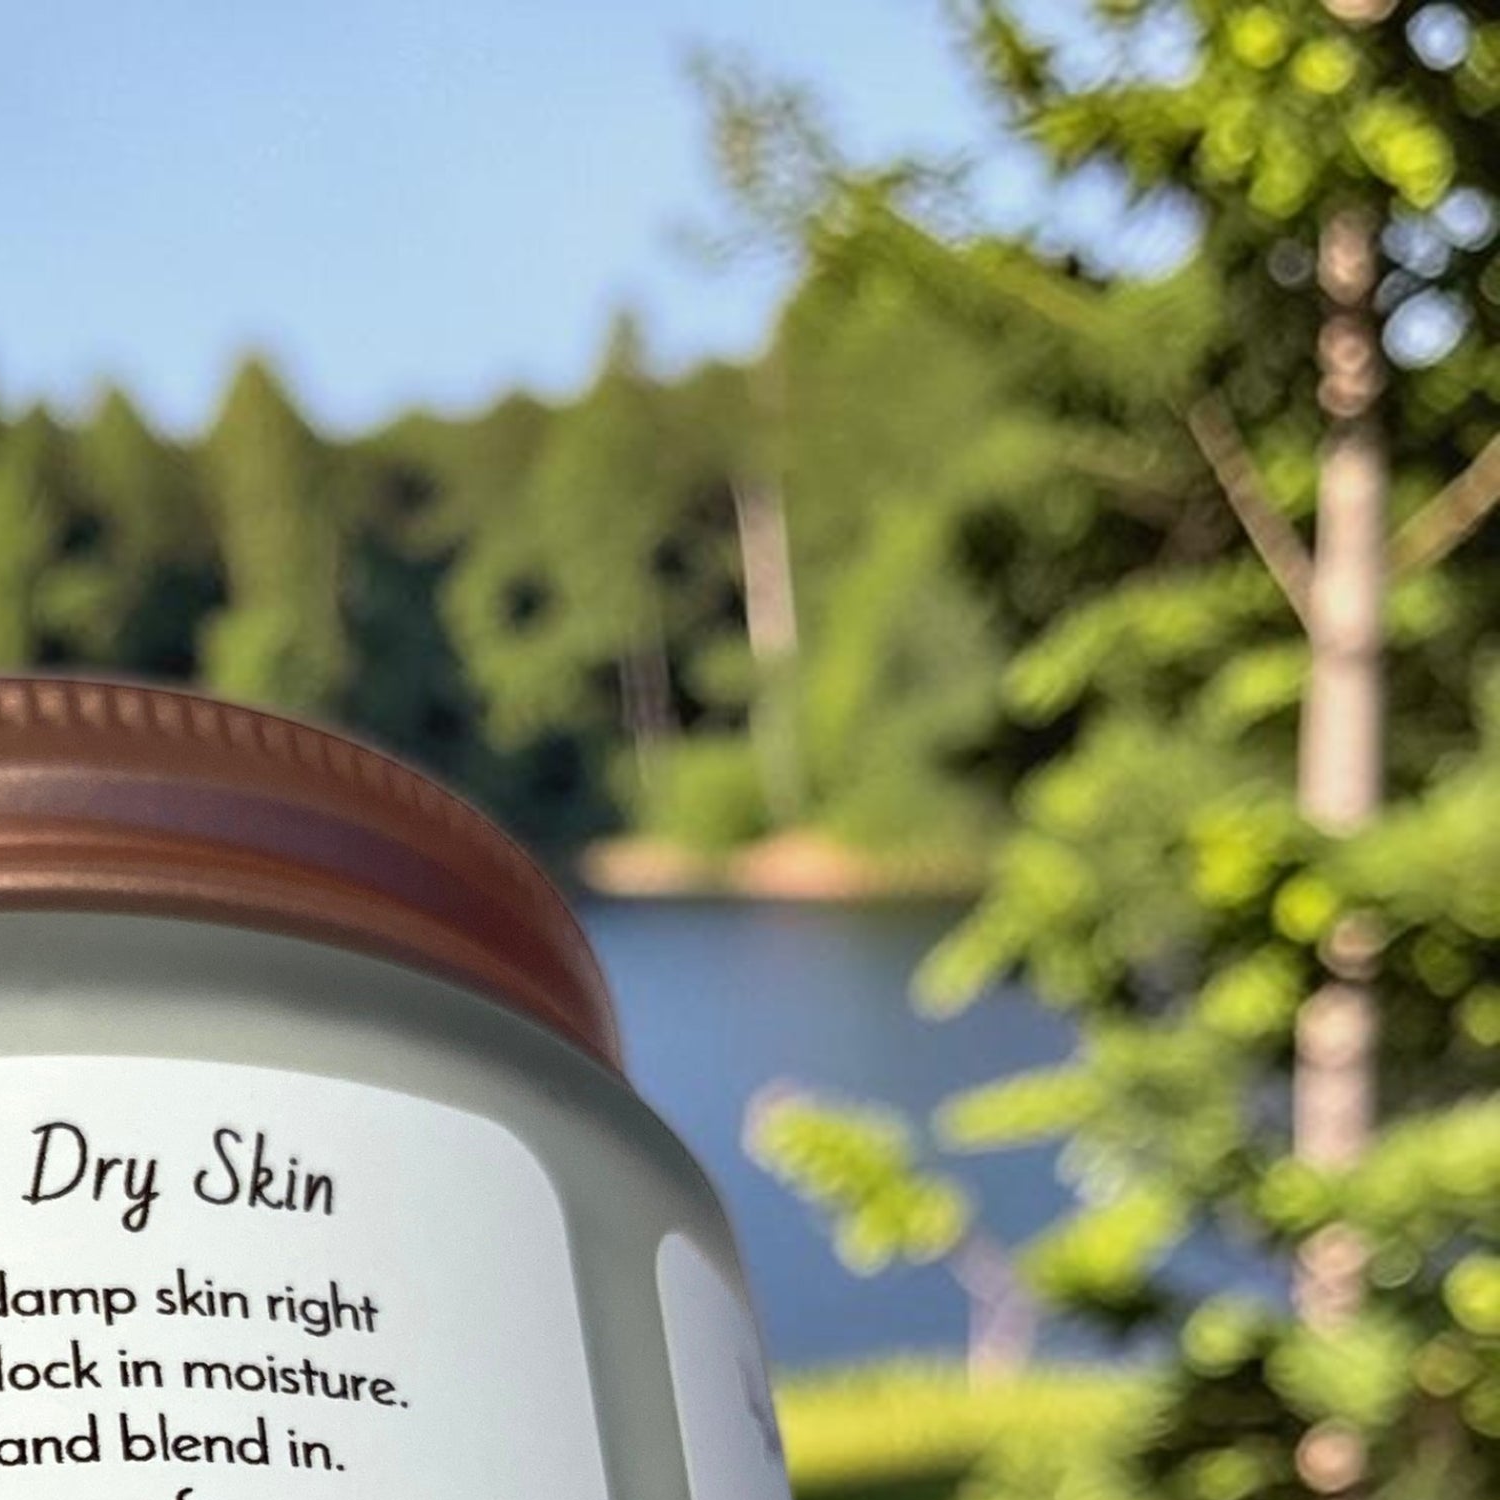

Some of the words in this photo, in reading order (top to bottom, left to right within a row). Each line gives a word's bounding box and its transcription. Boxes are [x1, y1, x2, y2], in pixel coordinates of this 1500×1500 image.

[20, 1120, 162, 1234] Dry
[192, 1126, 335, 1217] Skin
[155, 1266, 251, 1321] skin
[265, 1279, 380, 1339] right
[116, 1348, 165, 1389] in
[181, 1354, 410, 1410] moisture.
[118, 1411, 271, 1467] blend
[286, 1428, 346, 1473] in.
